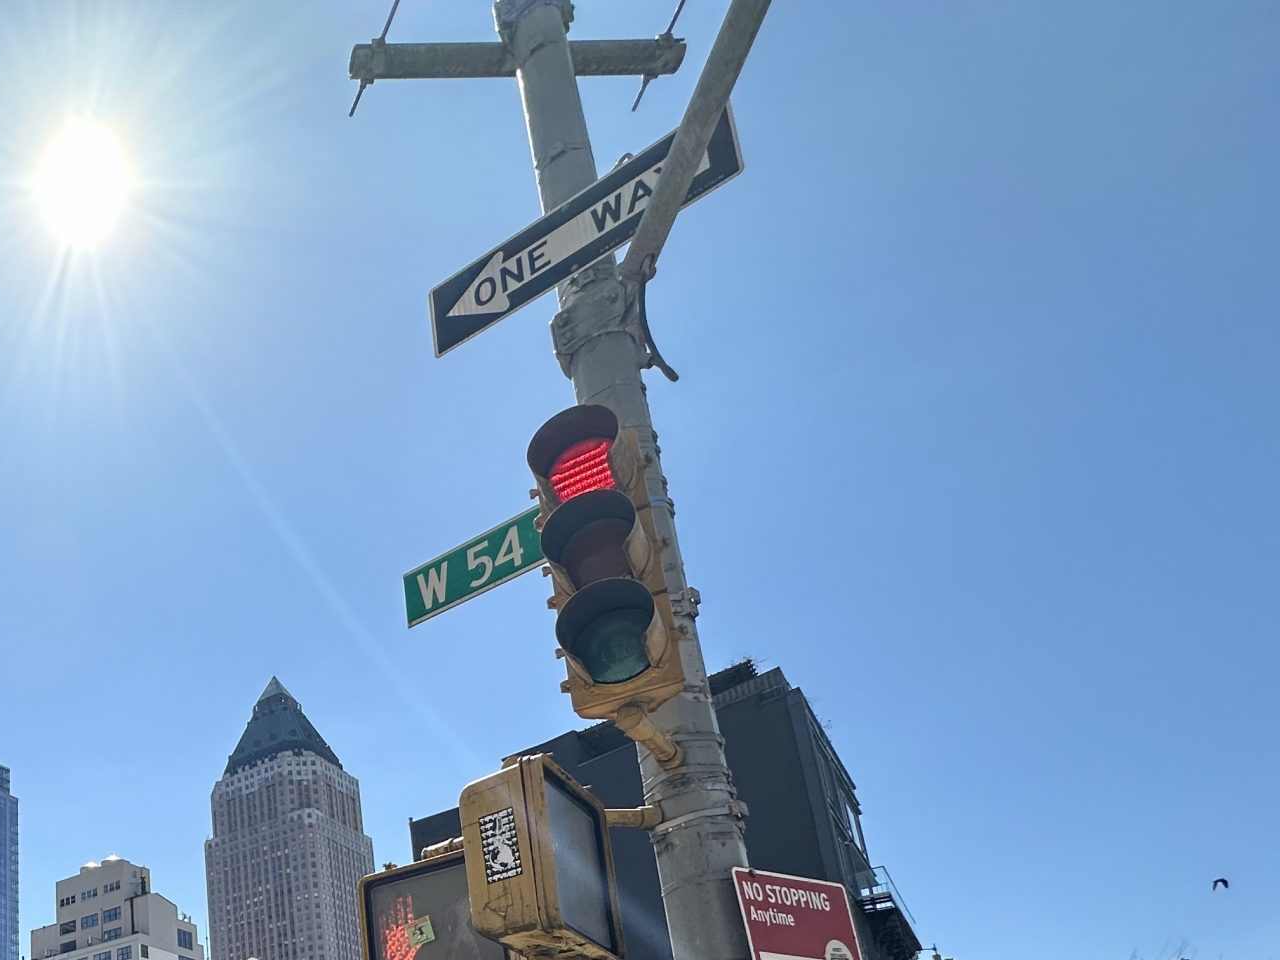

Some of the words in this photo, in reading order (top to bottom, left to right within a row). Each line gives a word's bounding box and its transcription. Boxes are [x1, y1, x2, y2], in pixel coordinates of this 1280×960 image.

[474, 240, 552, 307] ONE
[590, 166, 663, 234] WA
[416, 560, 448, 610] W
[466, 525, 524, 588] 54
[741, 880, 763, 902] NO
[765, 884, 831, 912] STOPPING
[750, 905, 796, 927] Anytime
